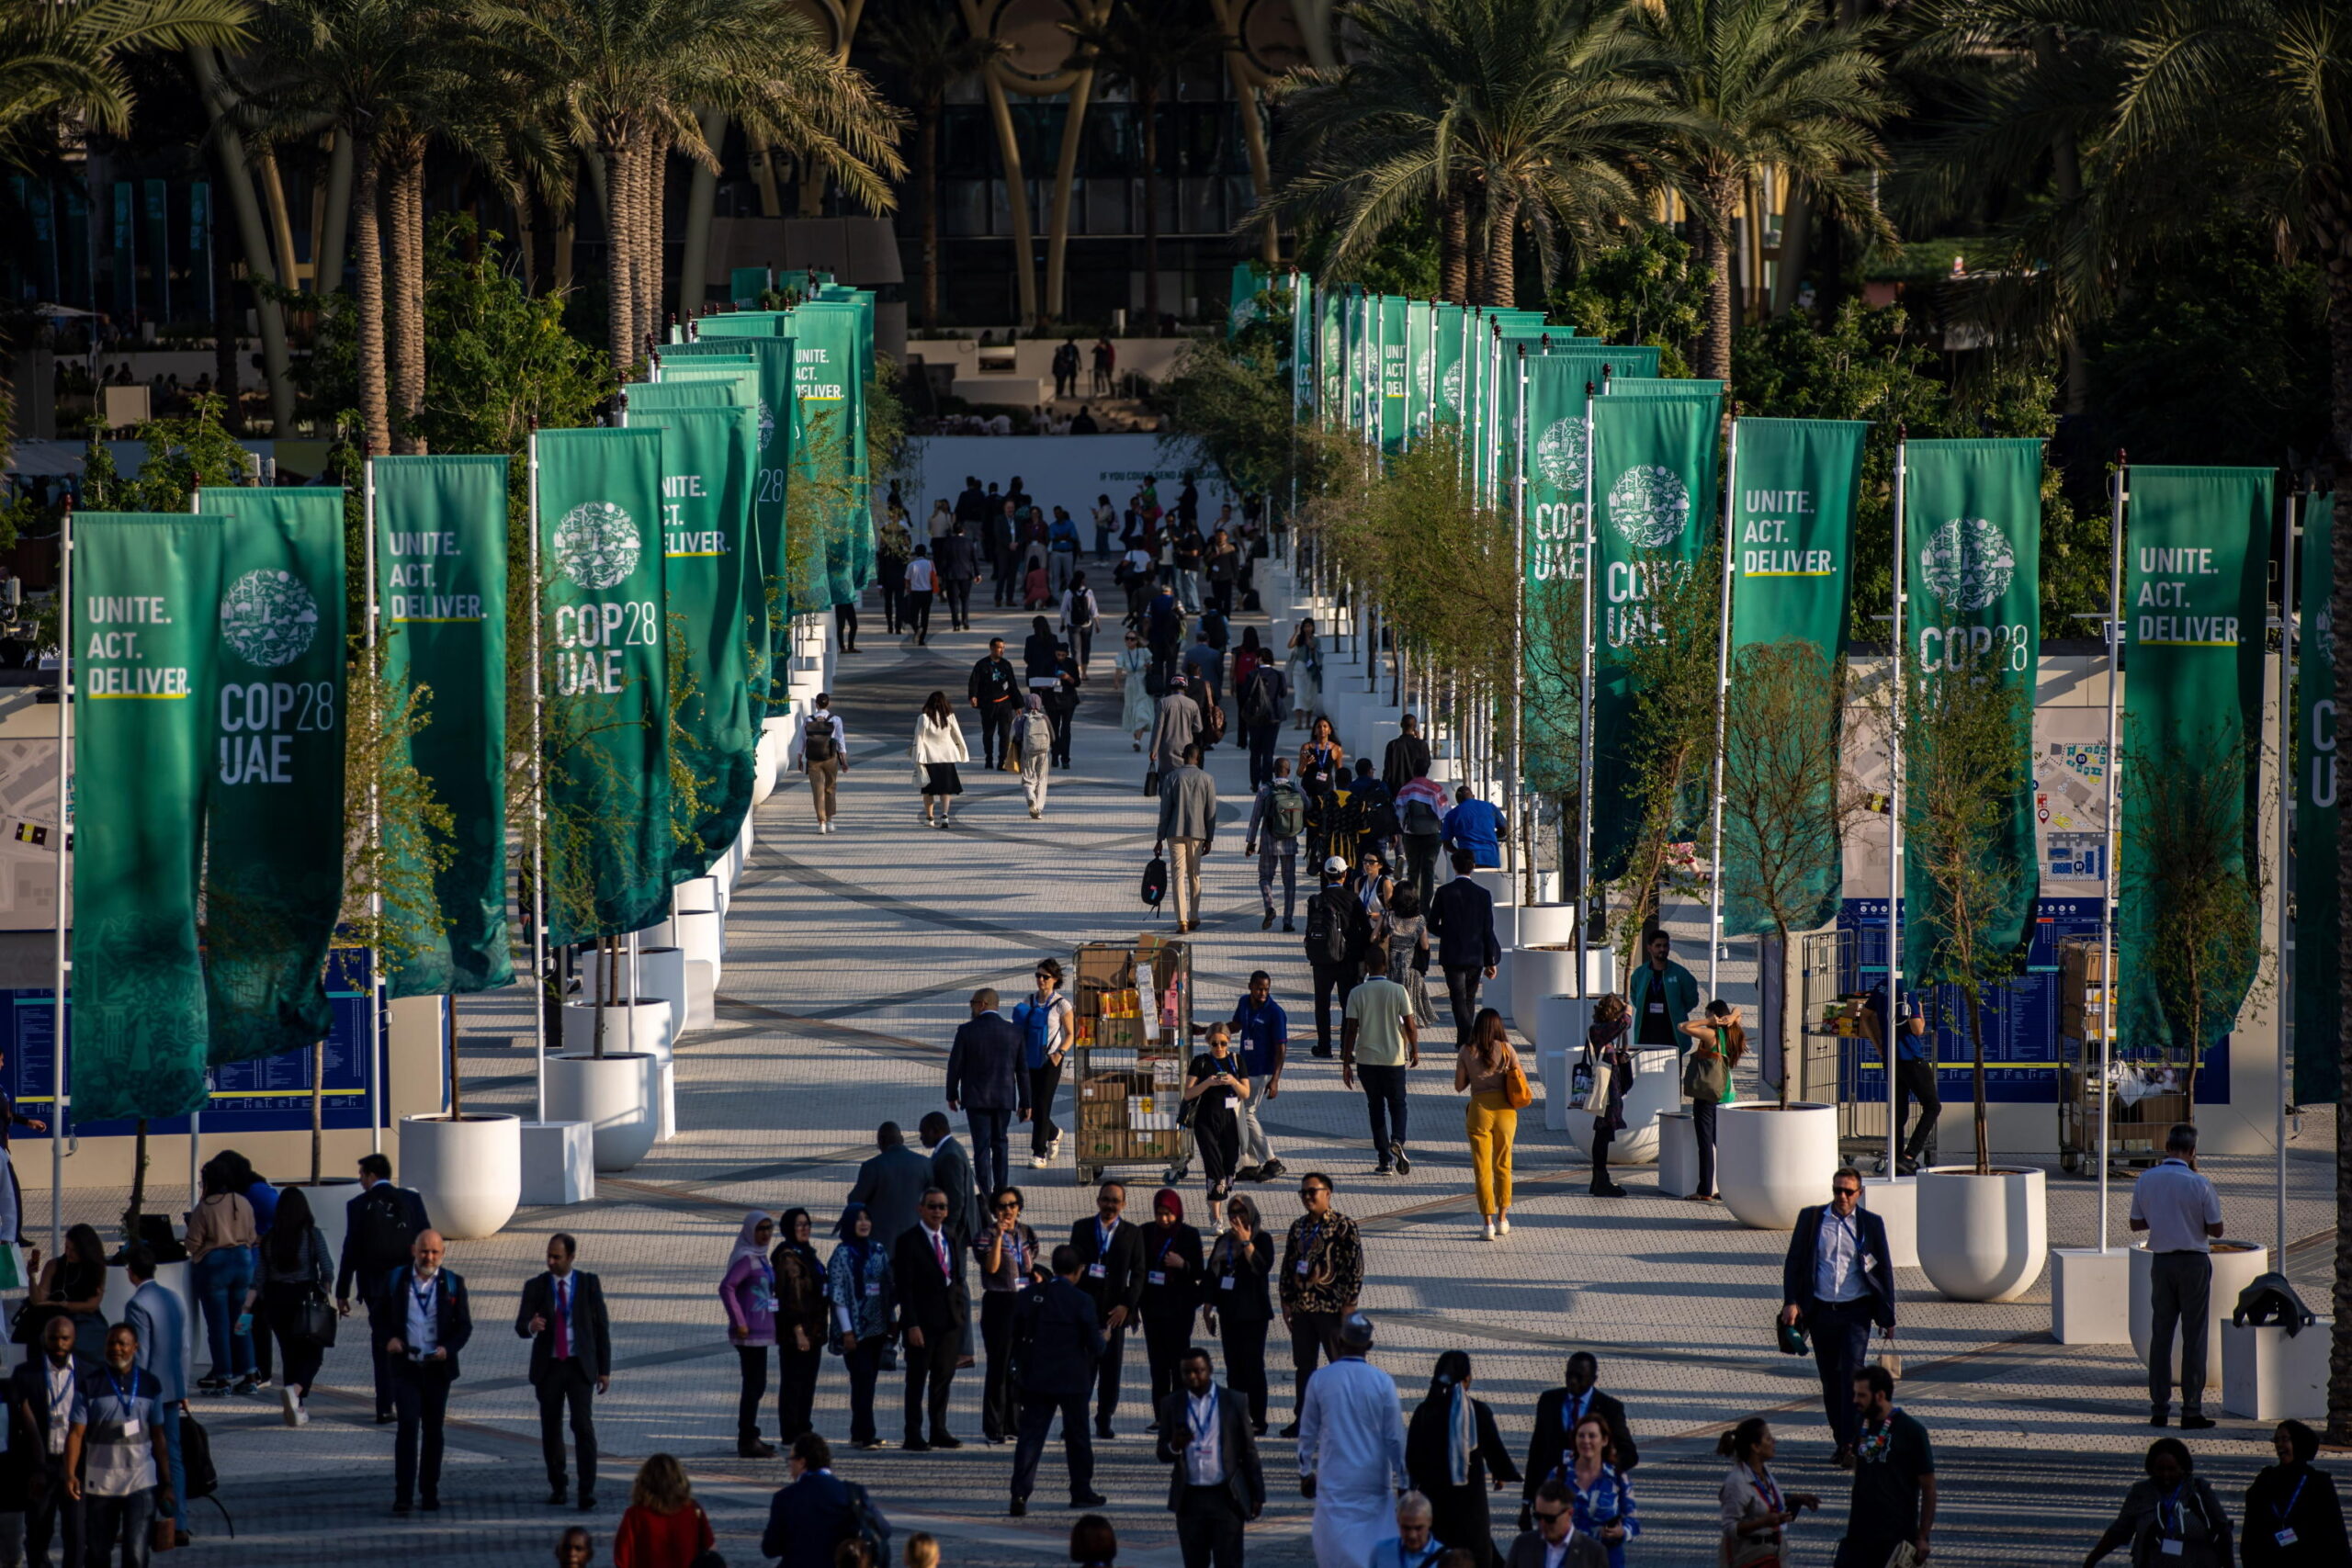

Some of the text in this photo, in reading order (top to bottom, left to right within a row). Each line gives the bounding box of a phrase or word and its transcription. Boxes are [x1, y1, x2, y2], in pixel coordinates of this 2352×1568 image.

[1110, 472, 1125, 480] YOU
[1746, 490, 1815, 513] UNITE.
[390, 532, 461, 557] UNITE.
[1743, 520, 1789, 544] ACT.
[1745, 549, 1838, 573] DELIVER.
[2140, 547, 2219, 574] UNITE.
[390, 563, 437, 588] ACT.
[391, 593, 488, 619] DELIVER.
[2137, 581, 2190, 608] ACT.
[88, 596, 172, 624] UNITE.
[556, 601, 657, 649] COP28
[2139, 615, 2247, 642] DELIVER.
[87, 632, 142, 660] ACT.
[1920, 625, 2028, 673] COP28
[88, 668, 192, 694] DELIVER.
[557, 649, 624, 696] UAE
[220, 681, 334, 732] COP28
[220, 736, 293, 785] UAE
